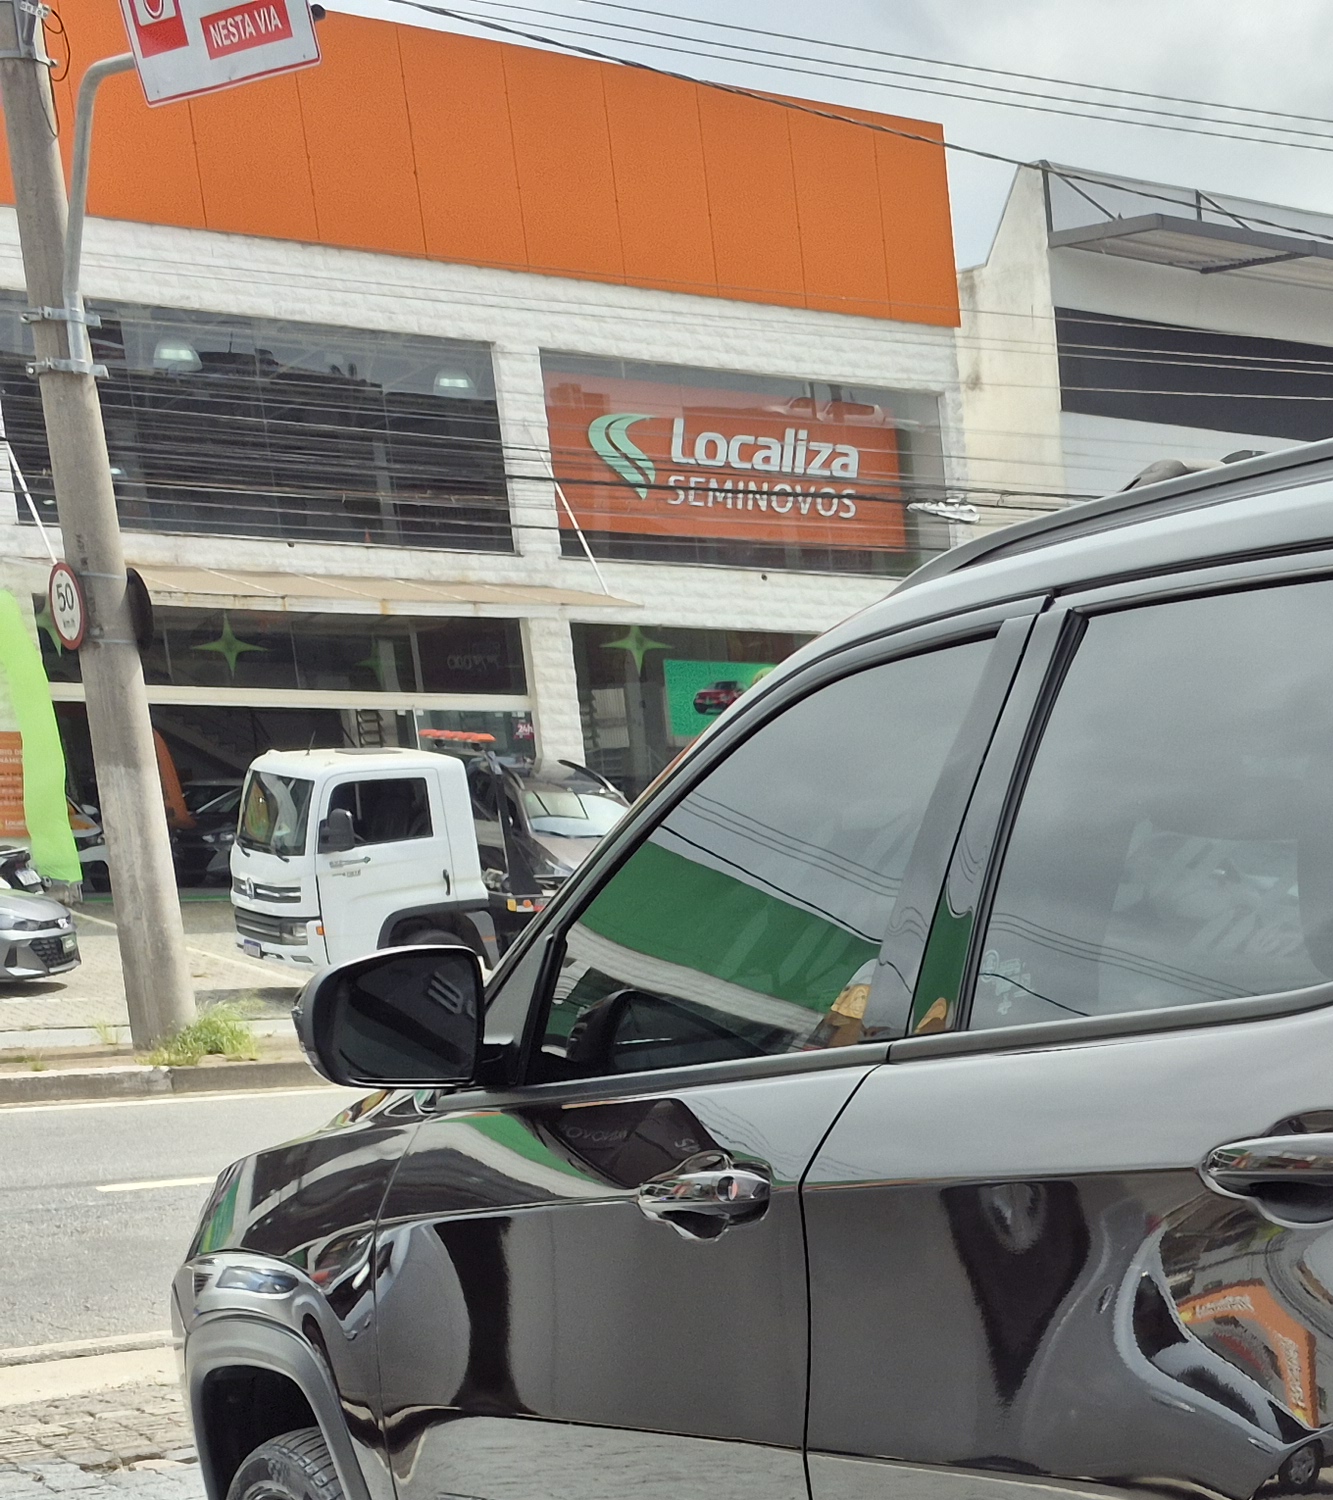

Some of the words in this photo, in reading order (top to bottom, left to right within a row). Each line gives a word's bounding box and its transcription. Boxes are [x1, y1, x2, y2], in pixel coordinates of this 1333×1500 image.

[209, 13, 256, 49] NESTA
[253, 5, 283, 35] VIA
[671, 417, 859, 478] Localiza
[667, 475, 857, 519] SEMINOVOS
[56, 583, 74, 612] 50
